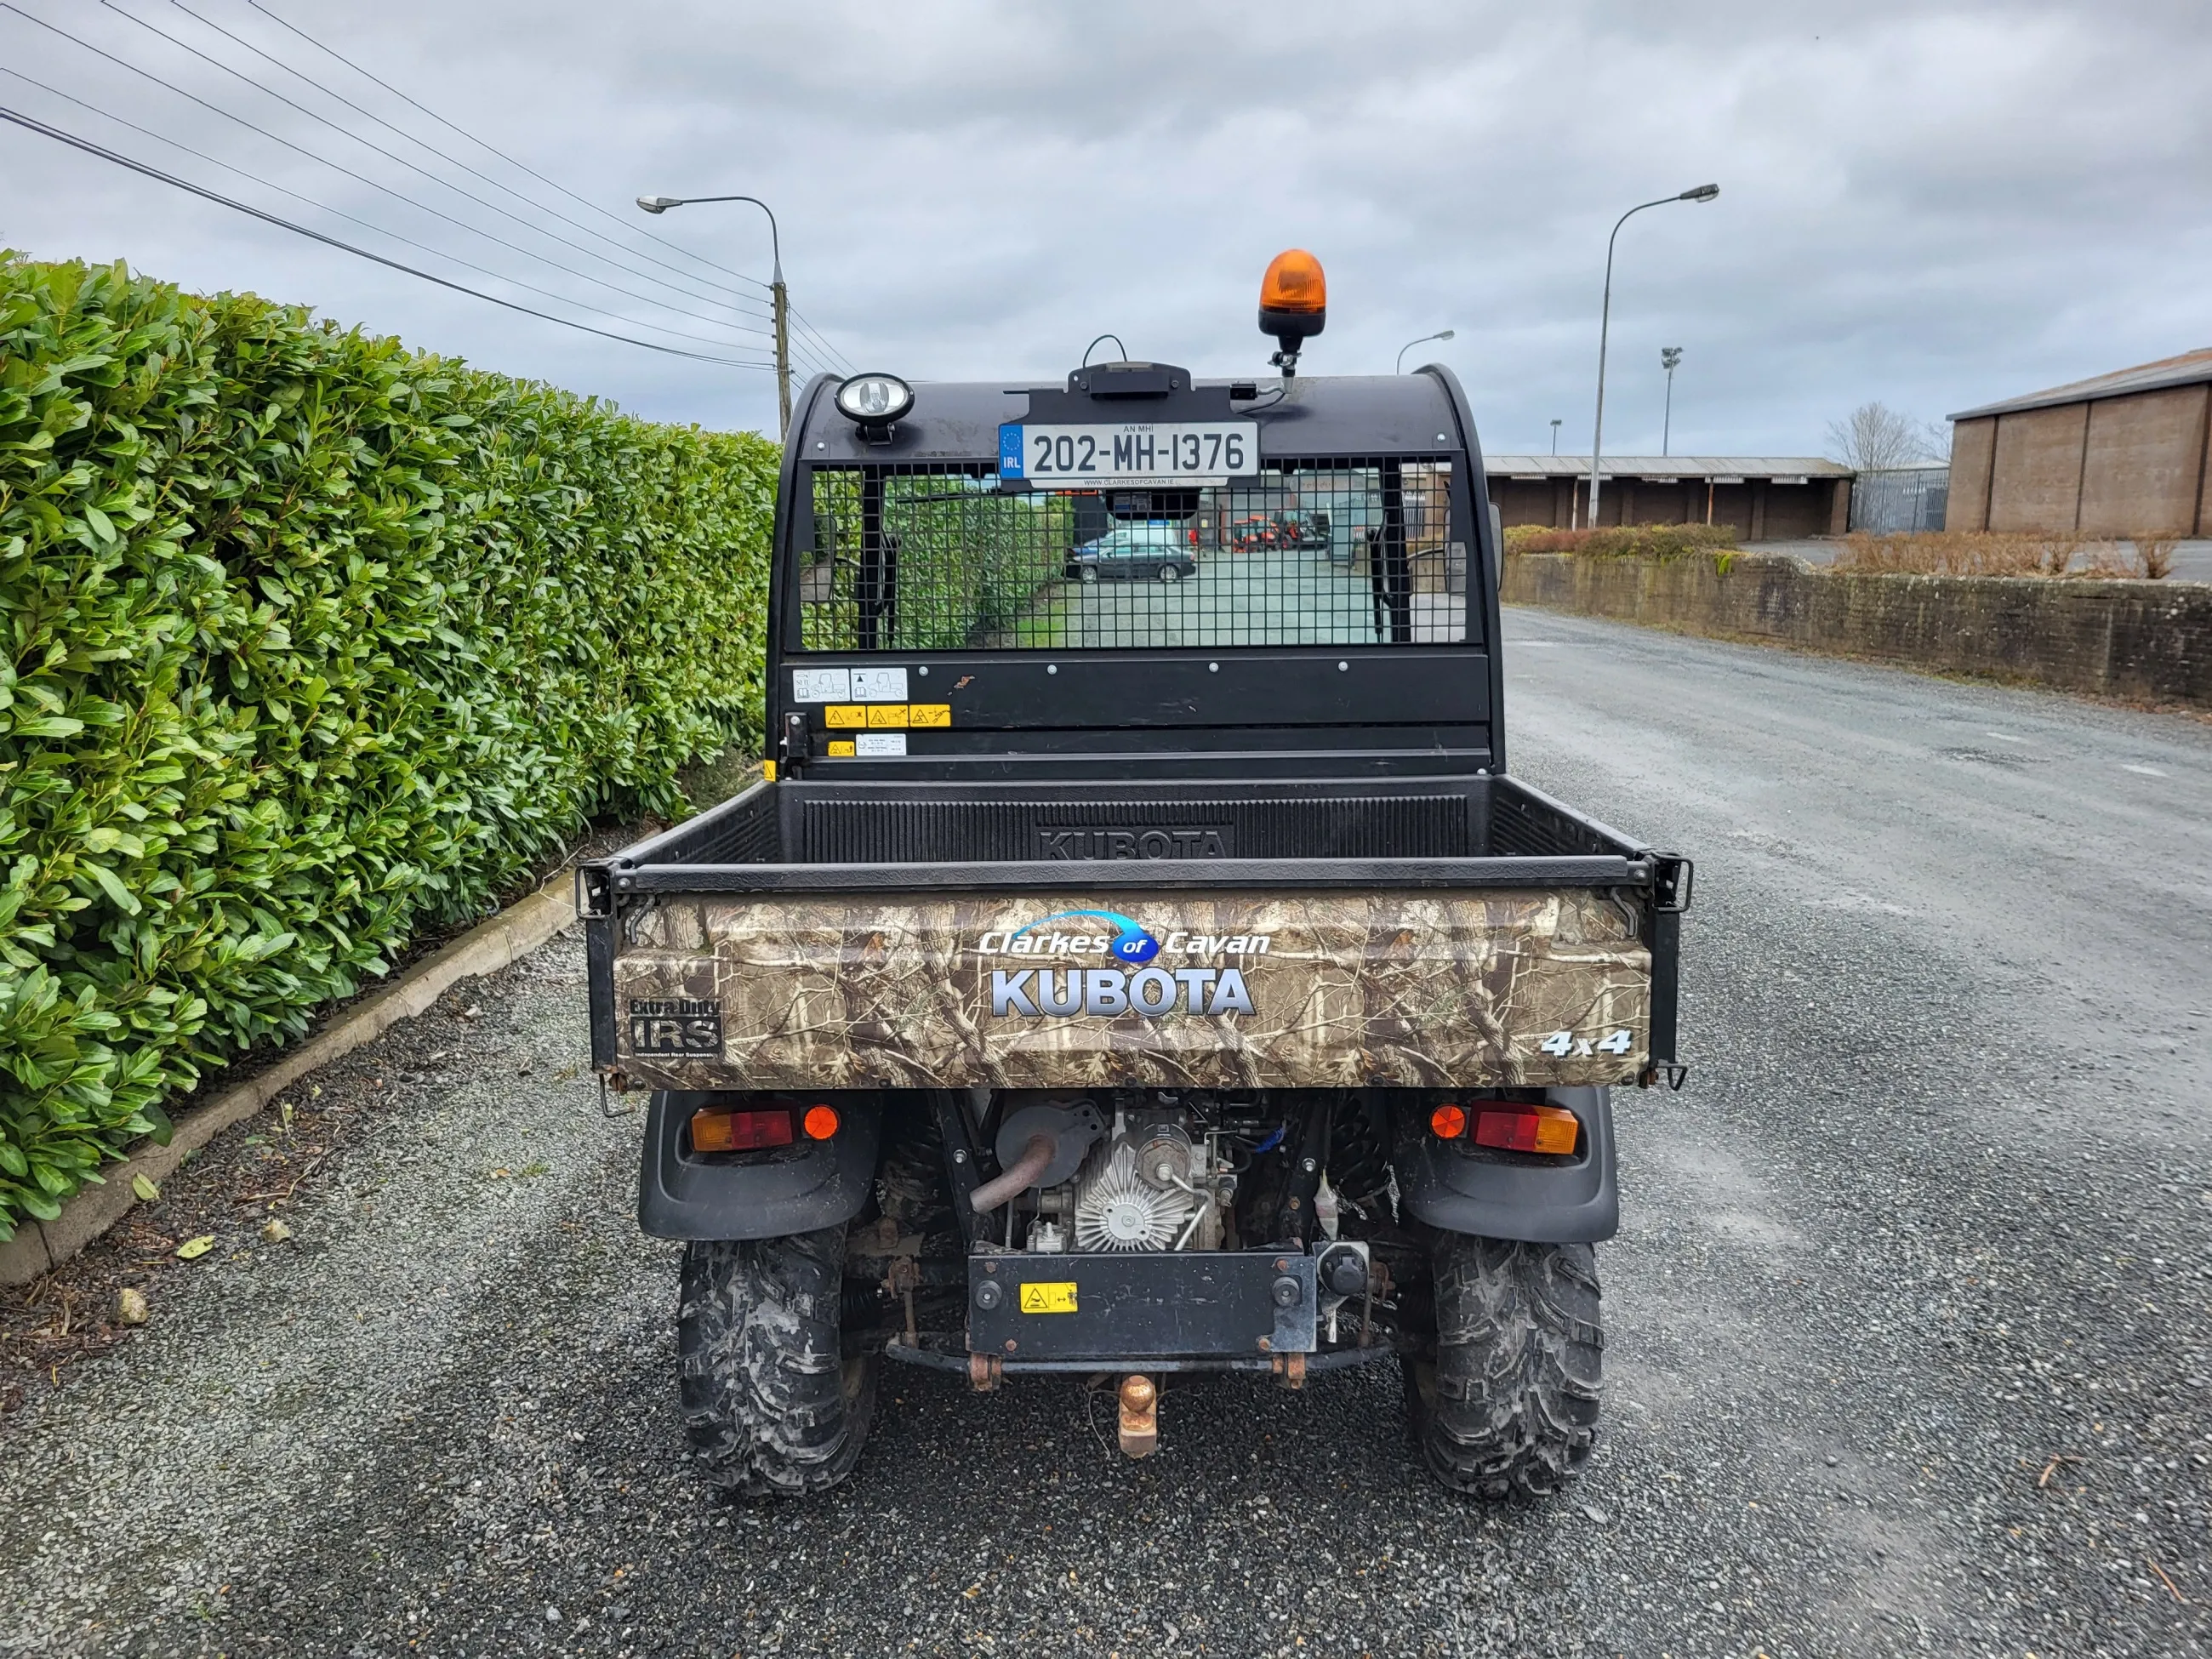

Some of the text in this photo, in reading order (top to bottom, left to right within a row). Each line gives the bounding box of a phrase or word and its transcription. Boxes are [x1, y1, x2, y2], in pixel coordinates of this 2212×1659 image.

[1123, 425, 1136, 433] AN
[1003, 456, 1021, 469] IRL
[1034, 435, 1244, 472] 202-MH-1376
[1083, 478, 1174, 487] WWW.CLARKESOFCAVAN.IE
[1040, 830, 1227, 859] KUBOTA
[978, 931, 1271, 955] Clarkes of Cavan
[992, 967, 1257, 1018] KUBOTA
[630, 999, 720, 1014] Extra Duty
[634, 1020, 719, 1047] IRS
[1541, 1029, 1633, 1058] 4x4
